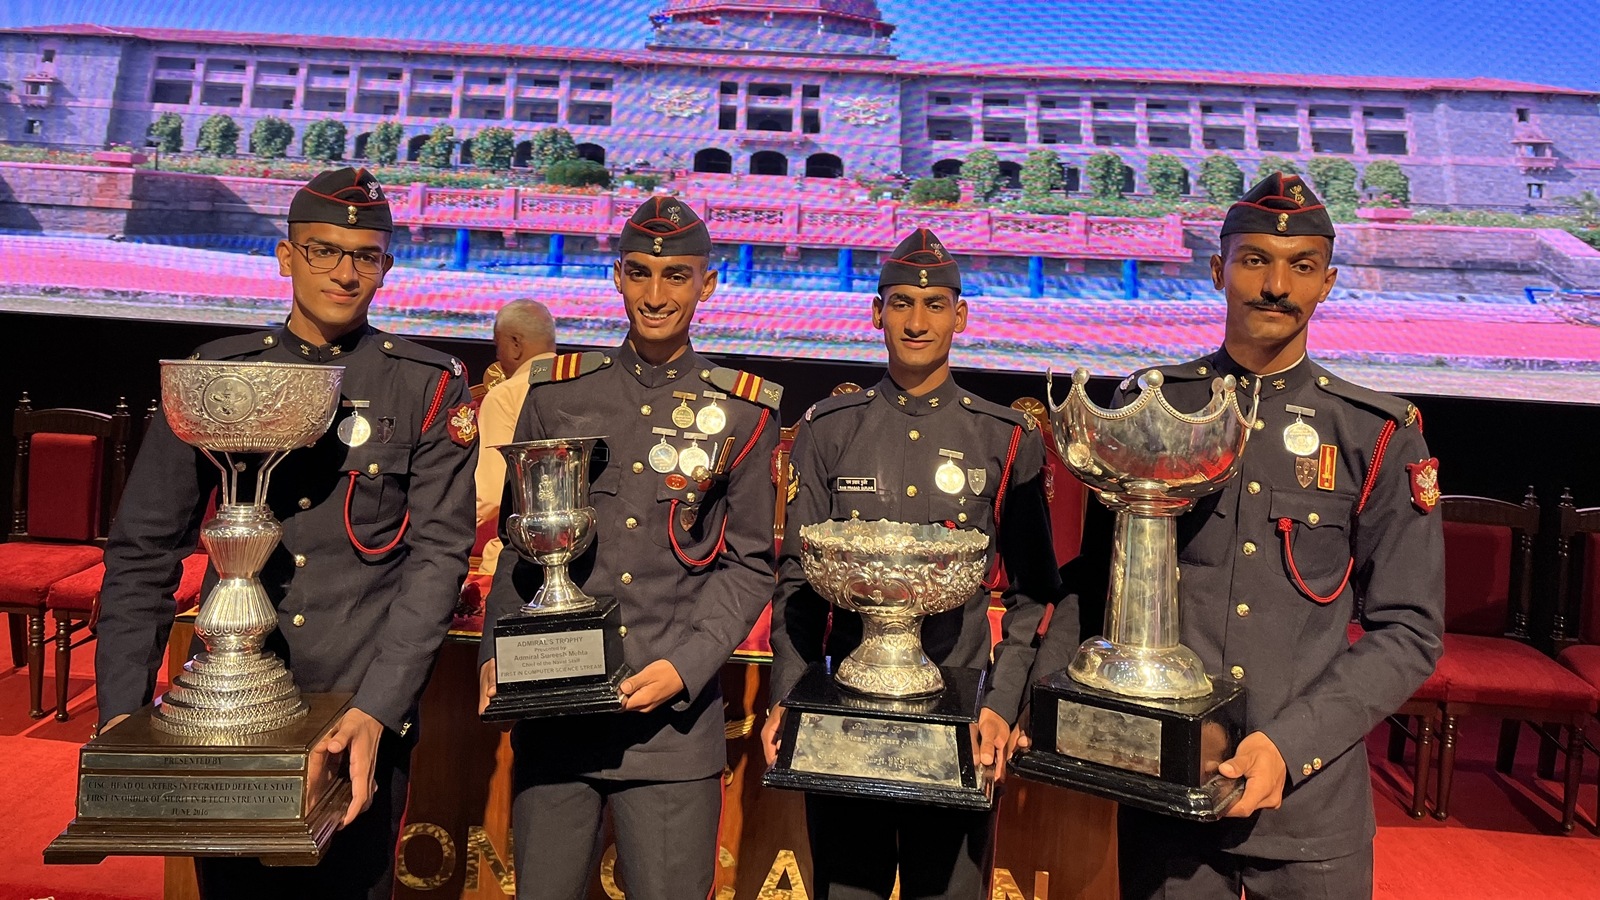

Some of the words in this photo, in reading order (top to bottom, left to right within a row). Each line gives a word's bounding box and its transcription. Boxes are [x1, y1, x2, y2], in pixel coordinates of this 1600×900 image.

[517, 639, 554, 648] ADMIRAL'S
[555, 636, 583, 645] TROPHY
[514, 653, 540, 661] Admiral
[568, 650, 588, 658] Mehta
[524, 668, 554, 676] COMPUTER
[555, 665, 579, 673] SCIENCE
[580, 663, 603, 671] STREAM
[164, 757, 211, 765] PRESENTED
[212, 757, 222, 765] BY
[179, 782, 231, 791] INTEGRATED
[232, 783, 269, 791] DEFENCE
[270, 783, 293, 791] STAFF
[86, 794, 108, 802] FIRST
[110, 794, 119, 802] IN
[121, 794, 149, 802] ORDER
[150, 795, 160, 803] OF
[163, 795, 189, 803] MERIT
[172, 808, 191, 816] JUNE
[193, 808, 208, 816] 2016
